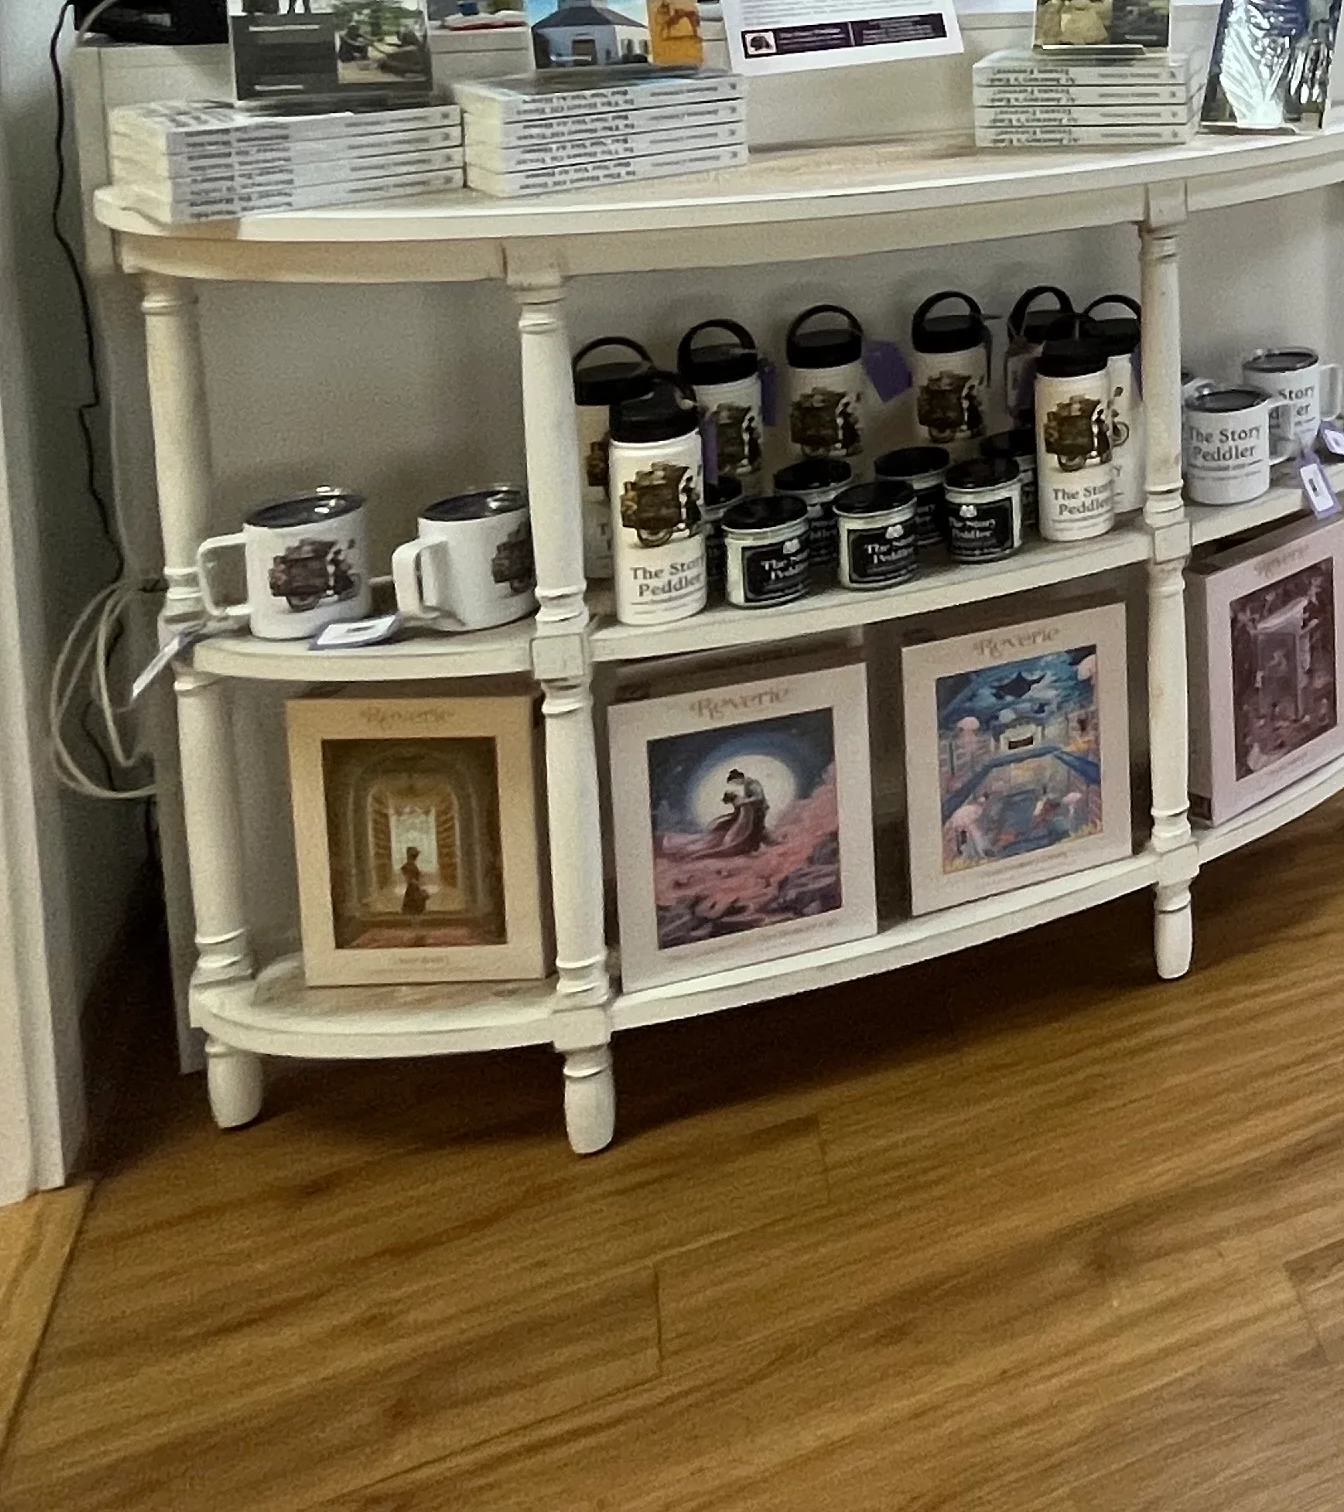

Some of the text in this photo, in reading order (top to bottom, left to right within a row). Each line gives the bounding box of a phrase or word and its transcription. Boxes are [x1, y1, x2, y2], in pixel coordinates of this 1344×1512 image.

[1188, 424, 1261, 445] The Story
[1192, 444, 1257, 463] Peddler
[1052, 487, 1081, 502] The
[630, 565, 665, 581] The
[638, 570, 702, 598] Peddler
[688, 686, 794, 719] Reverie
